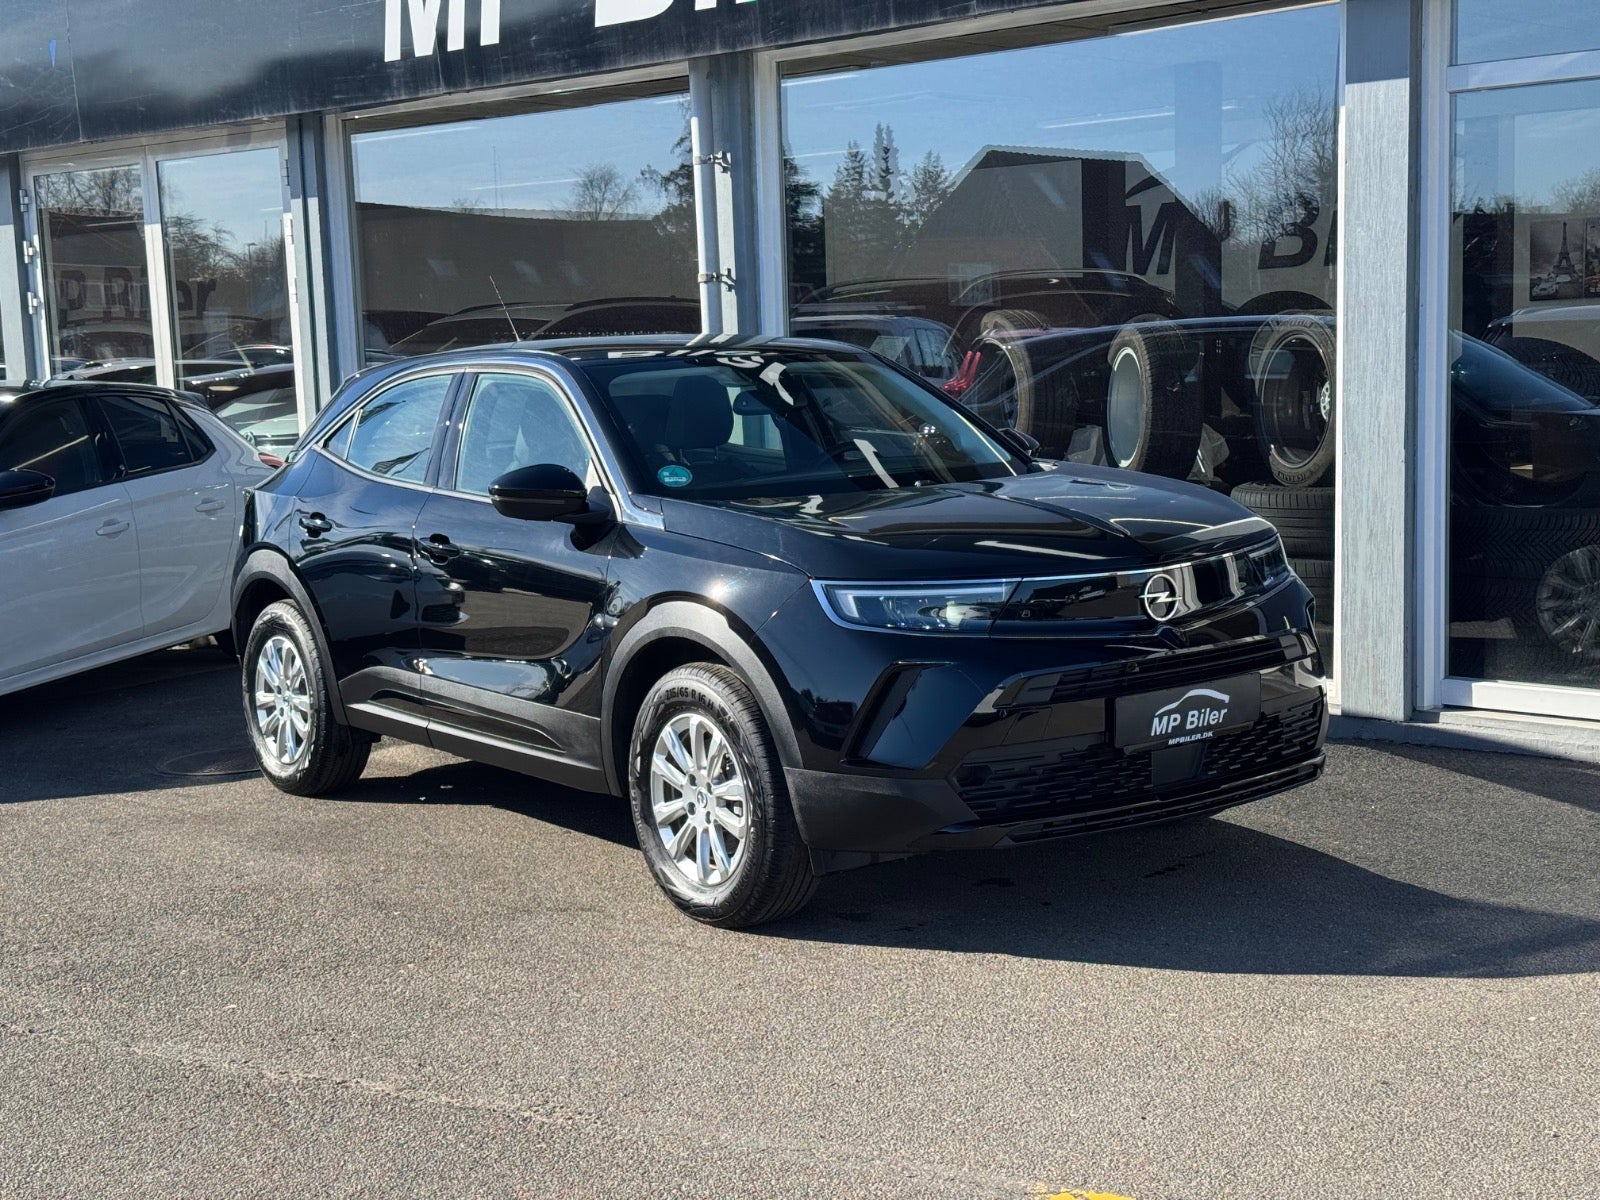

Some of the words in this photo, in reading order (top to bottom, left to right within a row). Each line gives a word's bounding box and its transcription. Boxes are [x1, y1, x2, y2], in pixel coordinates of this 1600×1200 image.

[665, 686, 689, 701] 215/65
[691, 688, 697, 700] R
[698, 692, 707, 705] 16
[1151, 713, 1181, 736] MP
[1186, 707, 1228, 730] Biler
[1168, 731, 1214, 745] MPBILER.DK
